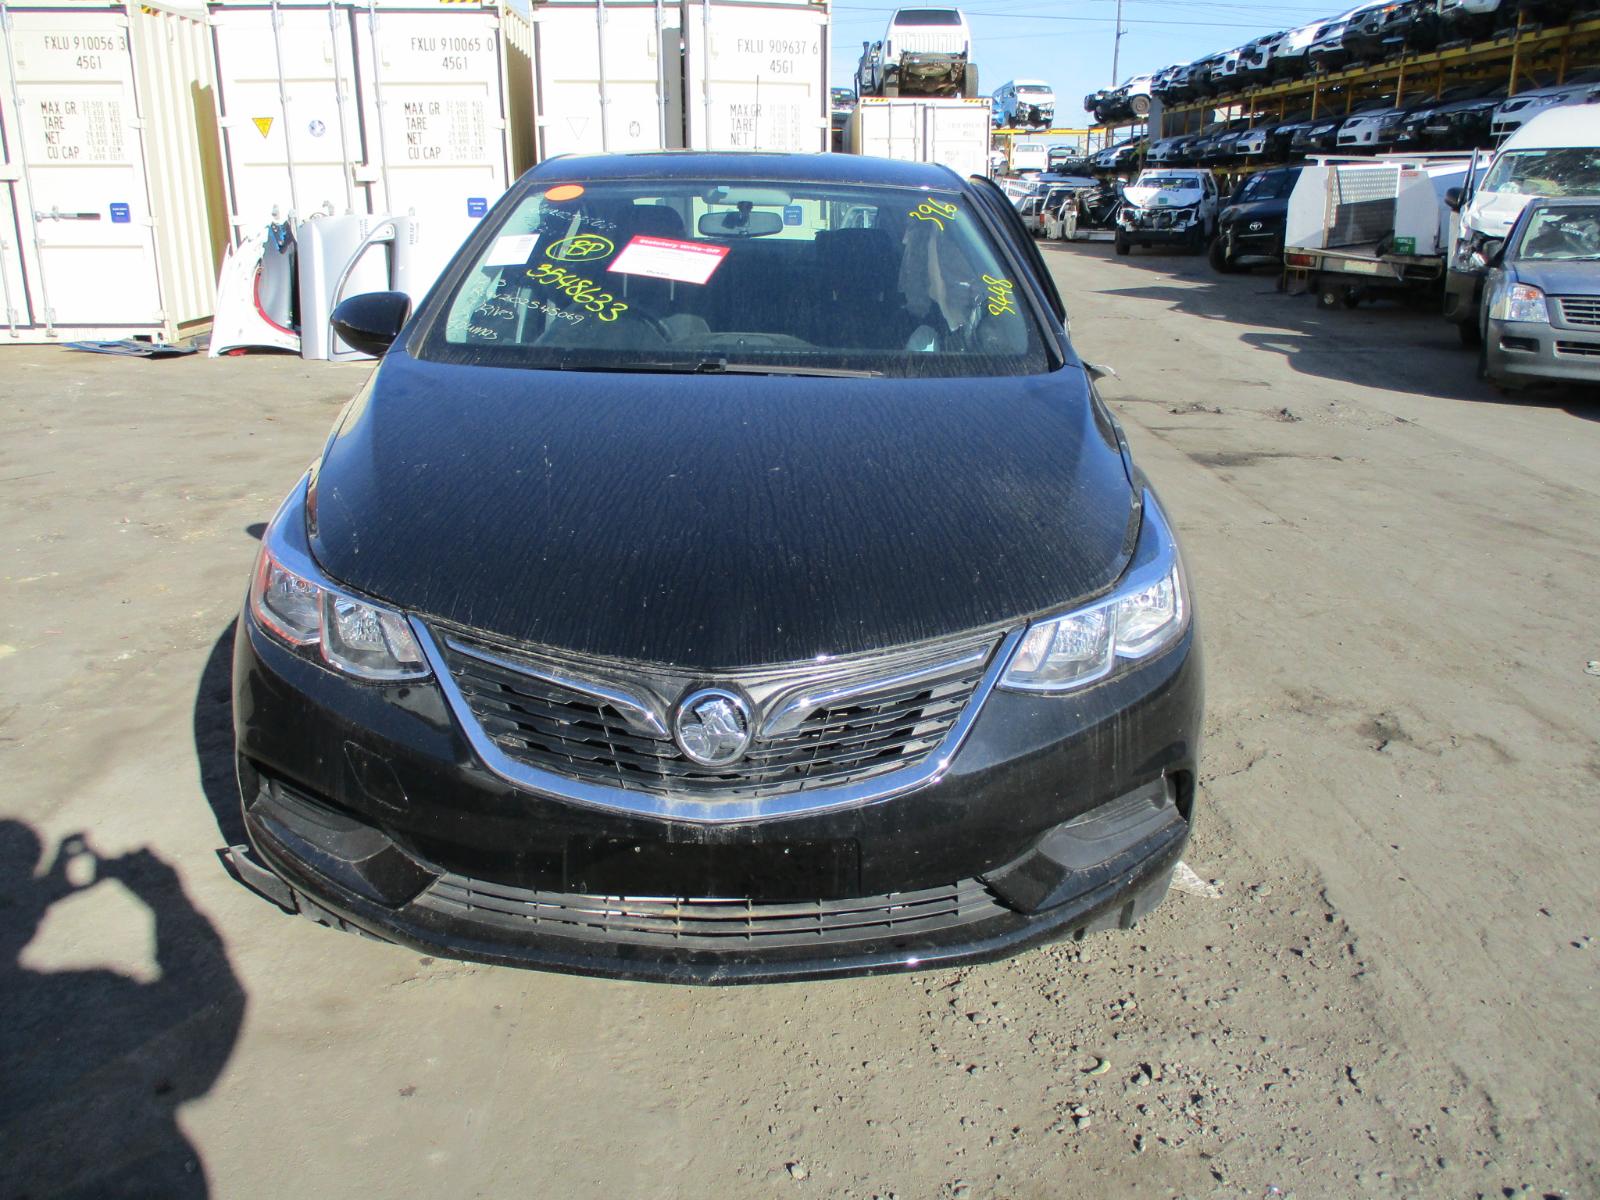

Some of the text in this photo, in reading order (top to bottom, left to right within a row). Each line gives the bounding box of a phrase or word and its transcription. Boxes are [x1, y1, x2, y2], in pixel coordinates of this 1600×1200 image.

[44, 36, 126, 50] FXLU 910056 3
[411, 37, 436, 51] FXLU
[440, 37, 481, 51] 910065
[737, 38, 819, 55] FXLU 909637 6
[76, 55, 103, 69] 45G1
[442, 56, 468, 70] 45G1
[769, 59, 794, 73] 45G1
[40, 101, 77, 115] MAX GR
[404, 101, 441, 115] MAX GR
[729, 103, 748, 117] MAX
[42, 116, 65, 130] TARE
[405, 116, 428, 130] TARE
[730, 118, 754, 132] TARE
[44, 131, 60, 145] NET
[407, 131, 422, 145] NET
[730, 132, 749, 146] NET
[423, 146, 442, 160] CAP
[526, 263, 629, 322] 3548633
